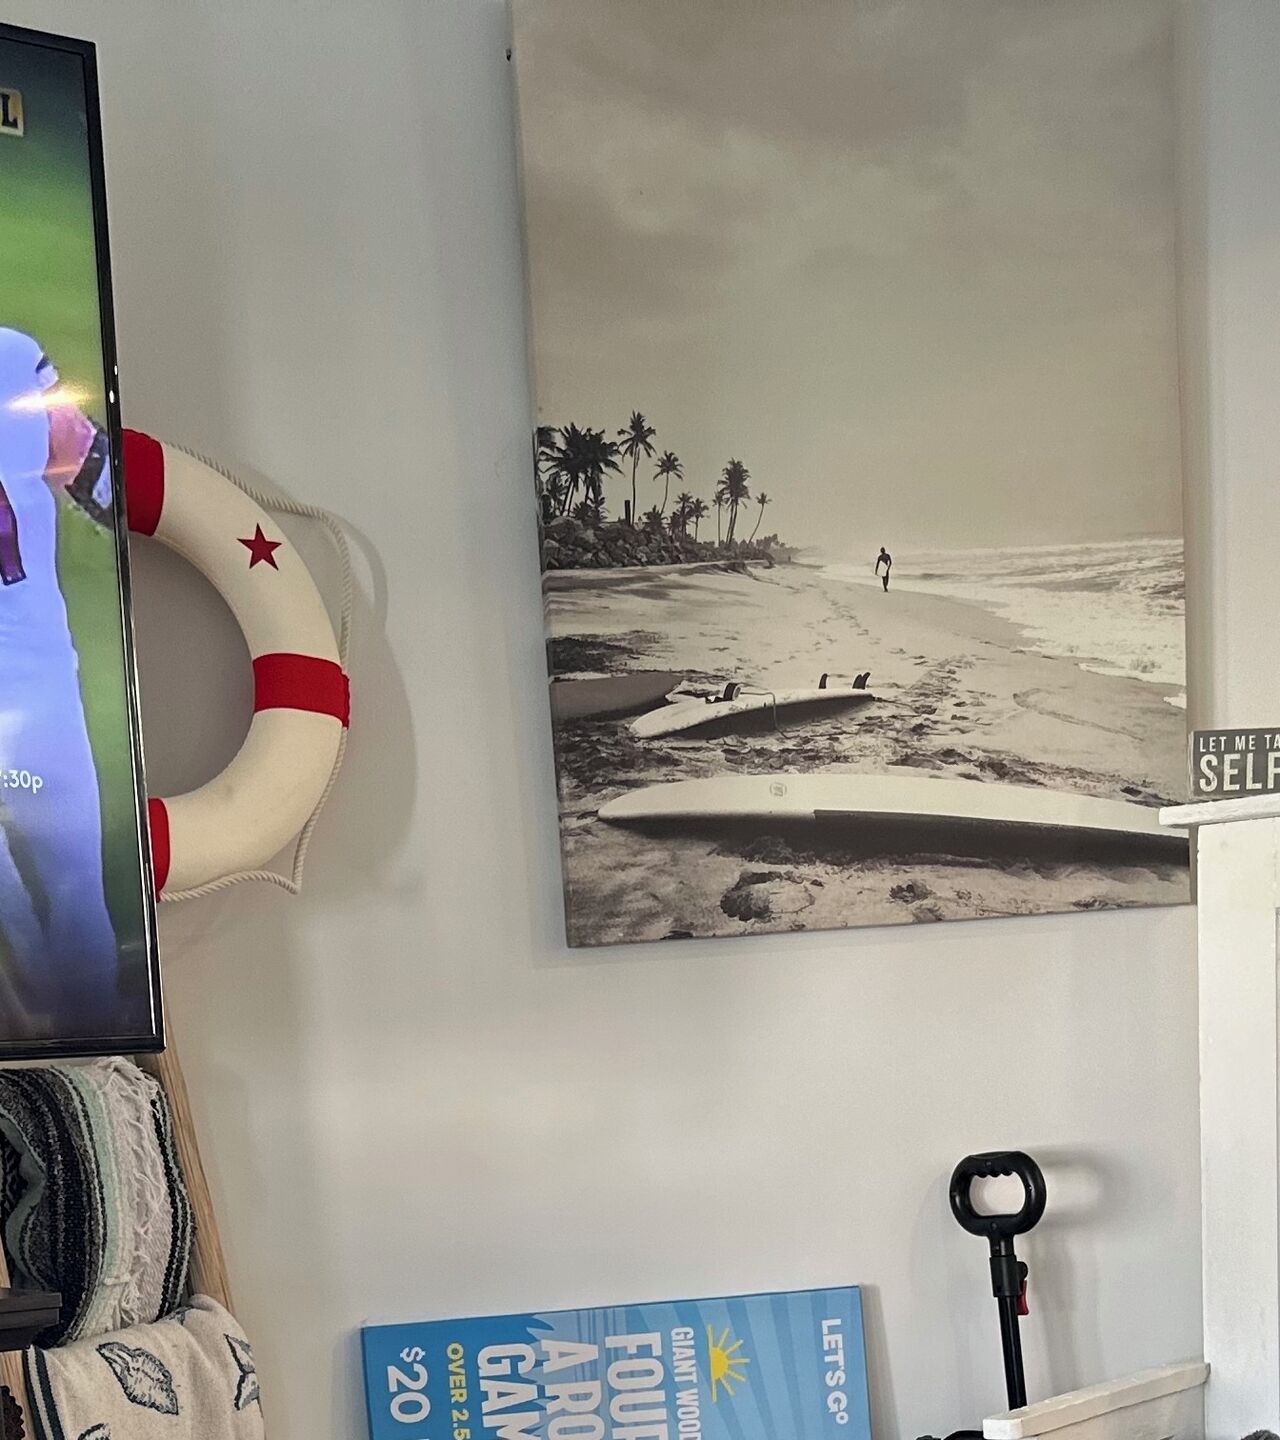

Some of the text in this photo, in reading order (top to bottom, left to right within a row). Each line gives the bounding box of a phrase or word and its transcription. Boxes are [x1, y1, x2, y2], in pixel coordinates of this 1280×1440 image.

[1199, 736, 1226, 752] LET
[1235, 735, 1256, 750] ME
[447, 1343, 467, 1403] OVER
[541, 1339, 599, 1374] A
[671, 1327, 698, 1383] GIANT
[822, 1319, 846, 1387] LET'S
[387, 1346, 431, 1423] $20
[452, 1409, 470, 1440] 2.5
